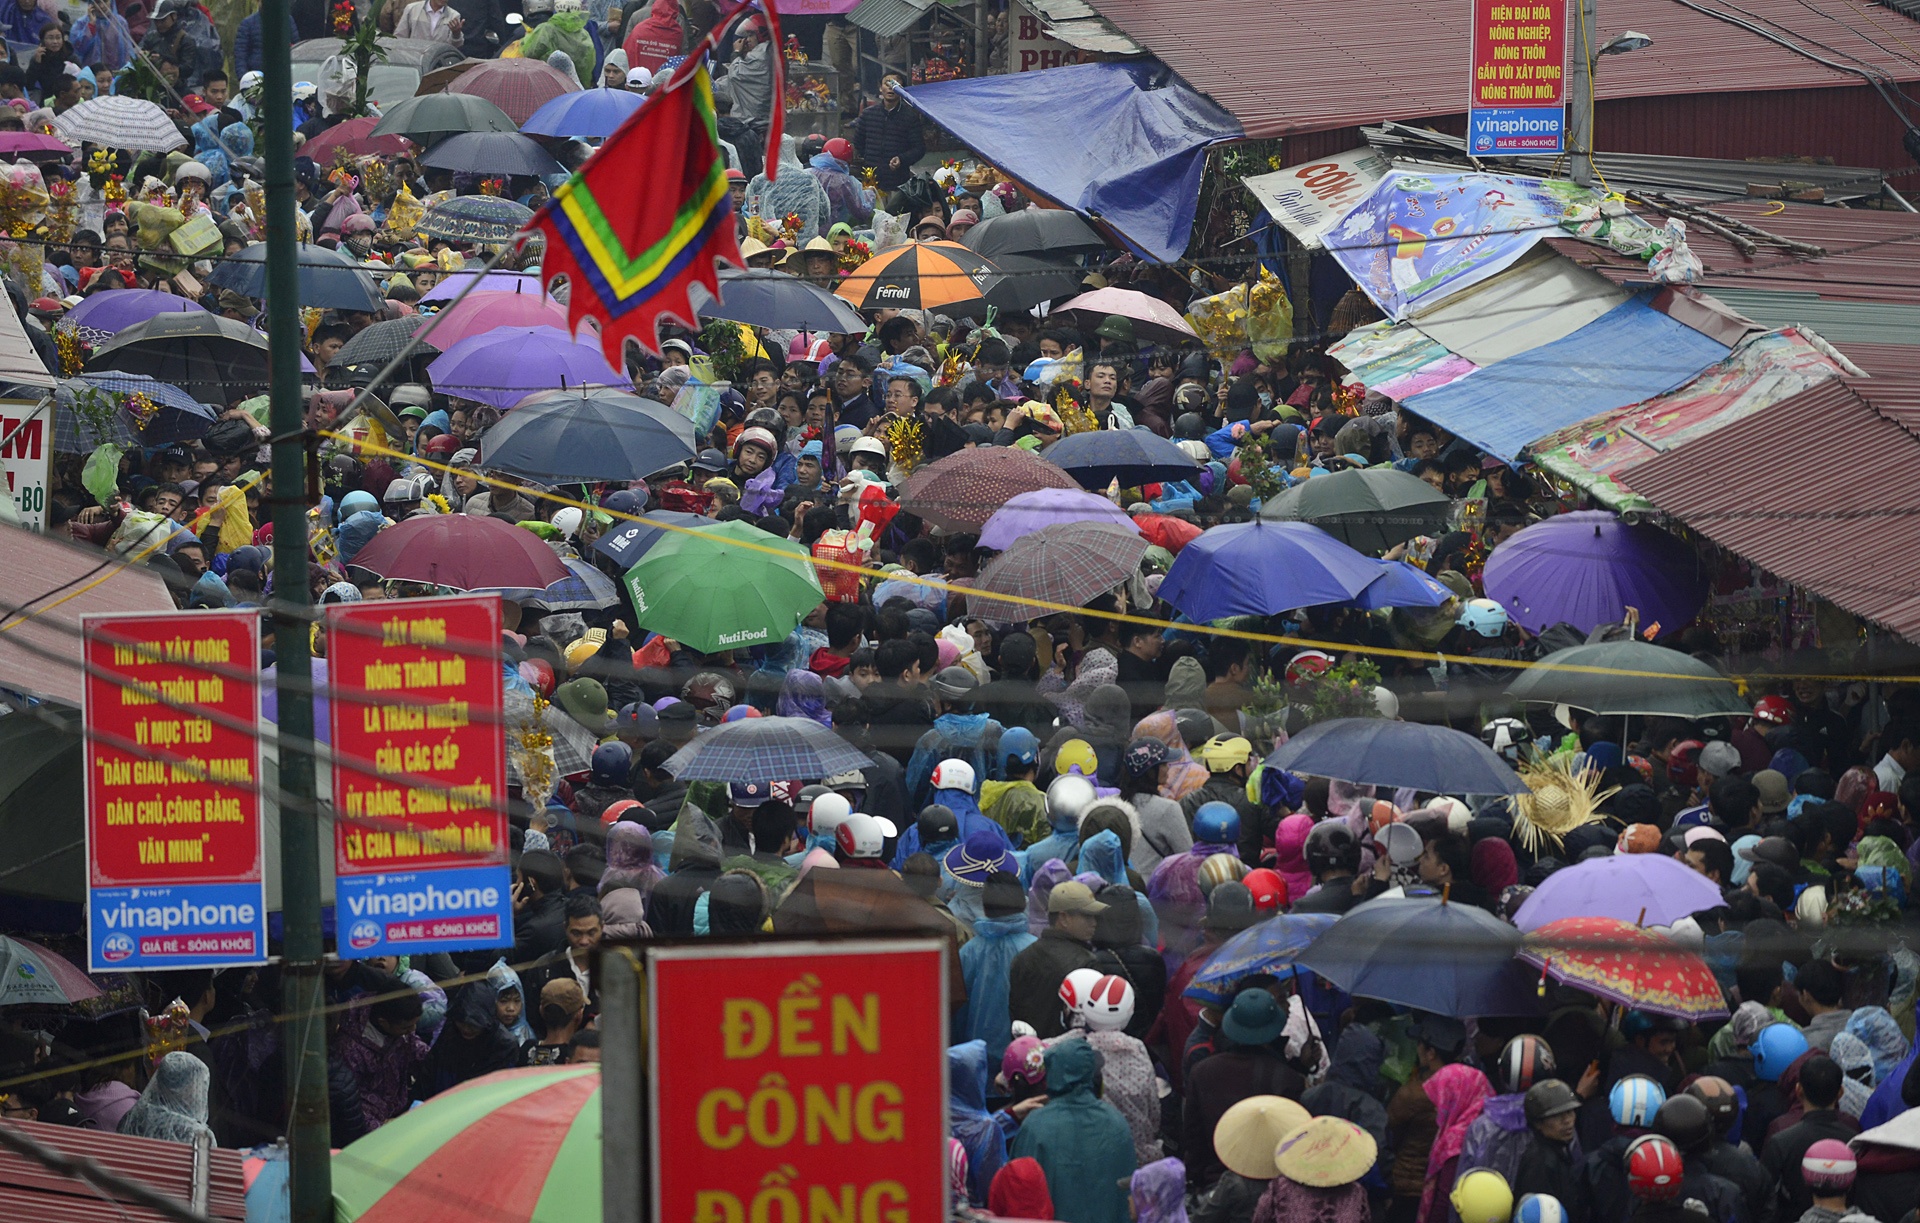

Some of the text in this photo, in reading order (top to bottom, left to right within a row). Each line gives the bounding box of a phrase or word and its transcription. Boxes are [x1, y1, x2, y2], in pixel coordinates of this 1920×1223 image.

[1491, 4, 1551, 23] HIỆN ĐẠI HÓA
[1489, 23, 1551, 42] NÔNG NGHIỆP,
[1494, 43, 1546, 59] NÔNG THÔN
[1478, 61, 1560, 82] GẮN VỚI XÂY DỰNG
[1481, 82, 1555, 99] NÔNG THÔN MỚI.
[1476, 117, 1559, 134] vinaphone
[1497, 139, 1507, 147] GIÁ
[1522, 139, 1538, 147] SÓNG
[876, 285, 911, 299] Ferroli
[630, 577, 649, 613] NutiFood
[382, 615, 447, 649] XÂY DỰNG
[719, 627, 768, 645] NutiFood
[114, 642, 134, 666] THI
[165, 636, 191, 663] XÂY
[194, 638, 230, 668] DỰNG
[365, 653, 466, 690] NÔNG THÔN MỚI
[121, 674, 224, 705] NÔNG THÔN MỚI
[364, 696, 469, 733] LÀ TRÁCH NHIỆM
[135, 716, 213, 749] VÌ MỤC TIÊU
[375, 735, 460, 774] CỦA CÁC CẤP
[134, 757, 168, 786] GIÀU,
[171, 755, 206, 783] NƯỚC
[209, 758, 253, 785] MẠNH,
[107, 797, 134, 825] DÂN
[204, 790, 244, 824] BẰNG,
[346, 784, 363, 818] ỦY
[407, 784, 447, 814] CHÍNH
[138, 836, 165, 864] VĂN
[346, 829, 364, 860] VÀ
[366, 826, 393, 859] CỦA
[423, 821, 462, 854] NGƯỜI
[464, 821, 495, 853] DÂN.
[142, 889, 172, 897] VNPT
[348, 884, 499, 917] vinaphone
[101, 899, 255, 931] vinaphone
[388, 924, 407, 940] GIÁ
[433, 921, 463, 937] SÓNG
[106, 938, 128, 951] 4G
[142, 937, 160, 953] GIÁ
[187, 937, 219, 952] SÓNG
[353, 925, 375, 939] 4G
[720, 972, 881, 1059] ĐỀN
[696, 1071, 905, 1149] CÔNG
[693, 1163, 910, 1223] ĐỒNG
